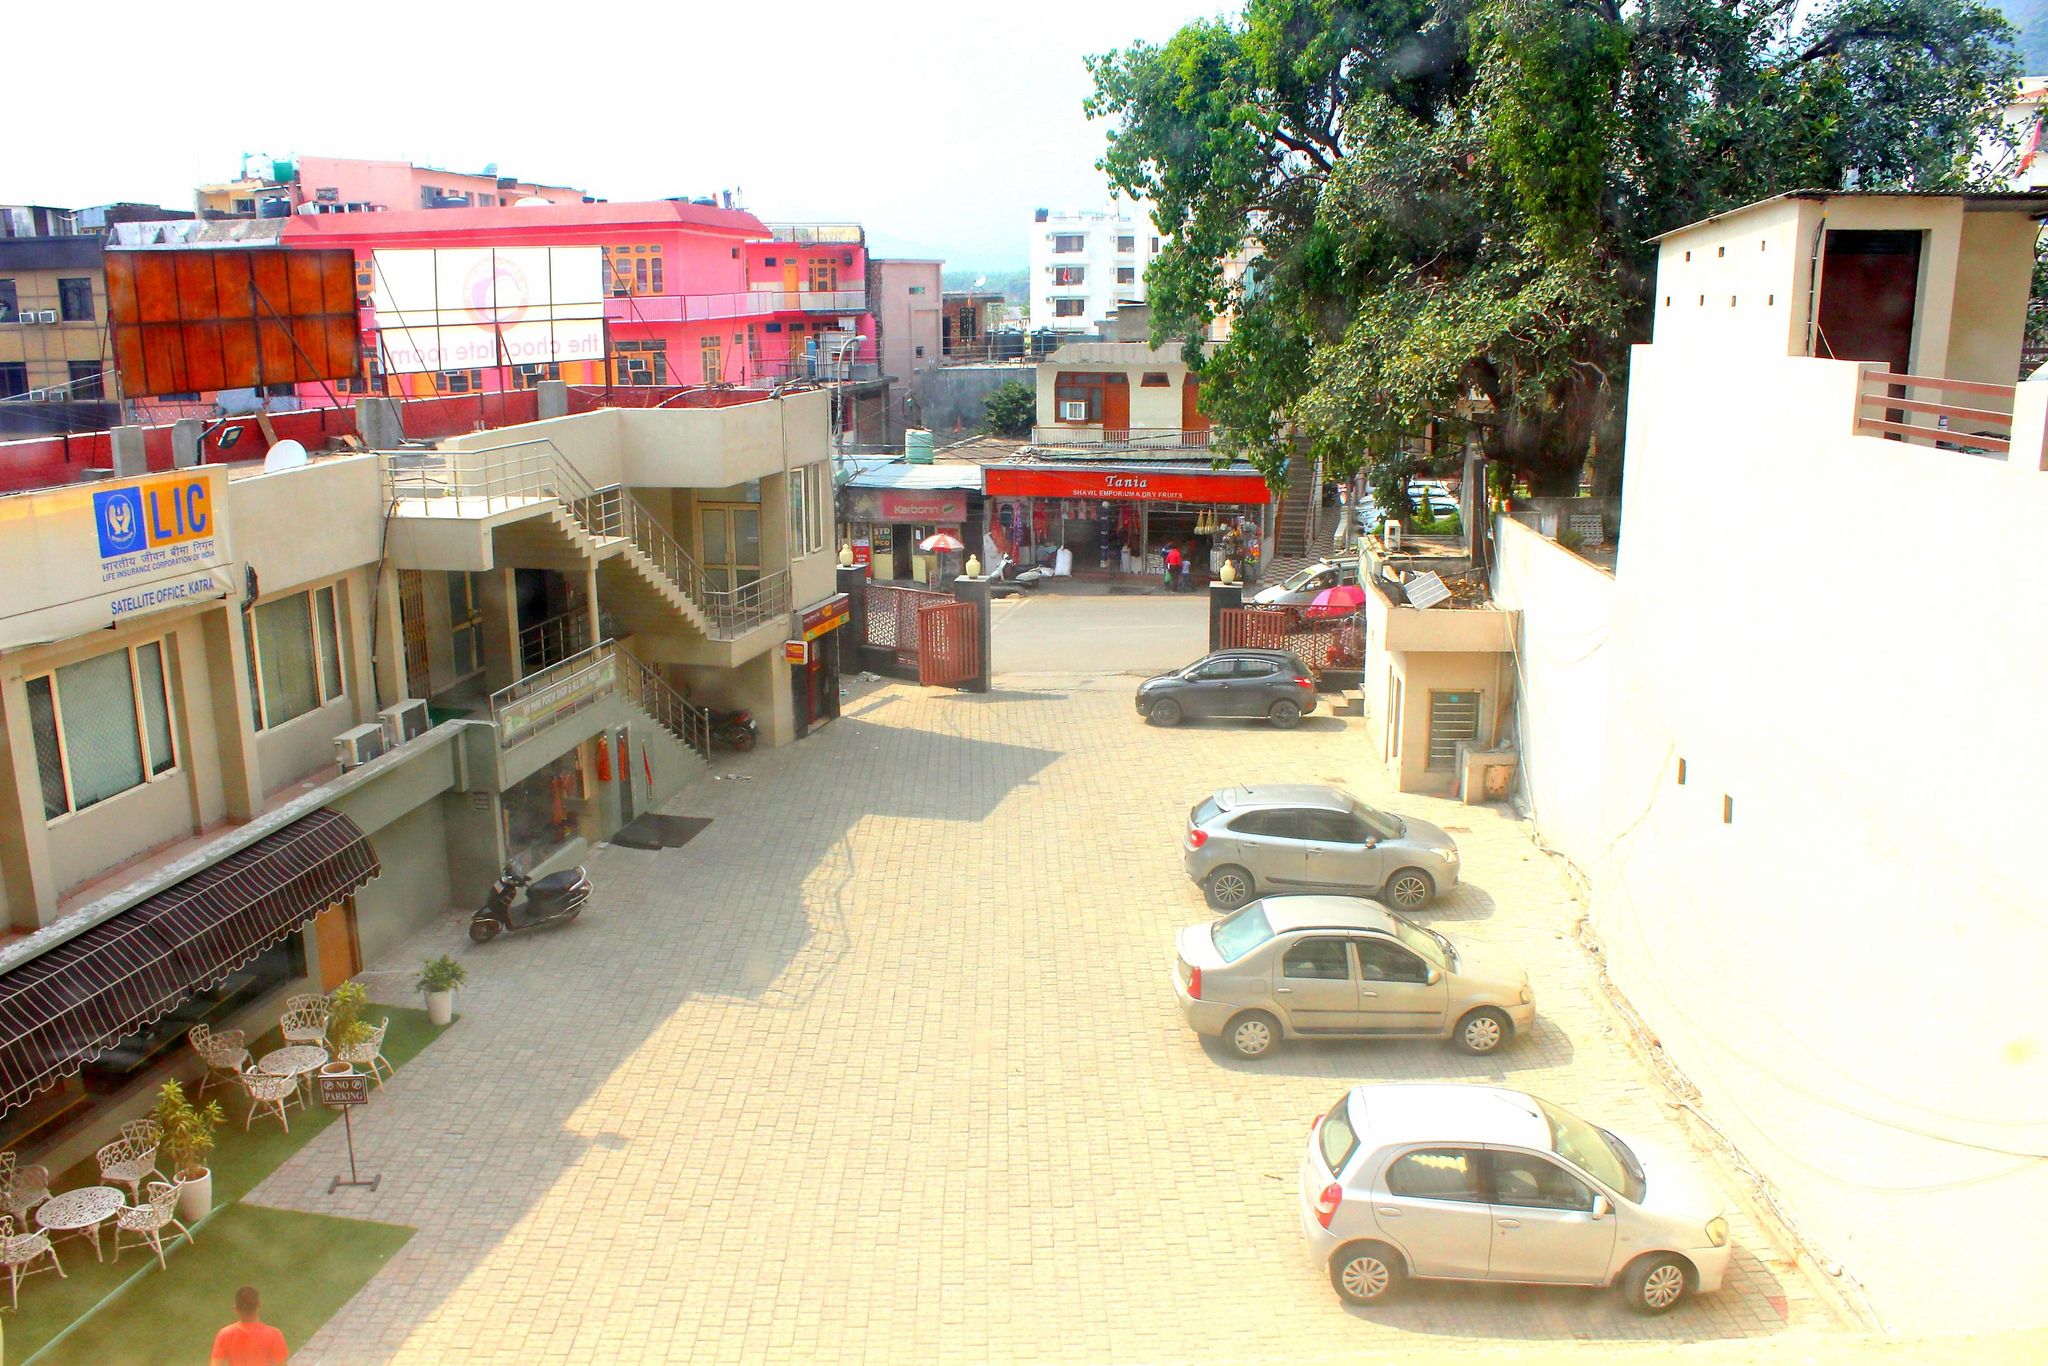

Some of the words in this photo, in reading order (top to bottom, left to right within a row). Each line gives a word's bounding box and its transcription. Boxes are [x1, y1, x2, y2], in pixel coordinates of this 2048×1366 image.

[1105, 475, 1148, 488] Tania
[150, 483, 206, 539] LIC
[873, 527, 890, 535] STD
[102, 556, 136, 572] भारतीय
[141, 550, 166, 563] जीवन
[170, 545, 189, 557] बीमा
[193, 540, 214, 551] निगम
[102, 573, 116, 582] LIFE
[117, 564, 152, 579] INSURANCE
[152, 555, 192, 571] CORPORATION
[192, 553, 200, 561] OF
[201, 550, 215, 559] INDIA
[111, 592, 155, 616] SATELLITE
[188, 578, 214, 595] KATRA
[325, 1091, 363, 1101] PARKING
[335, 1081, 349, 1089] NO
